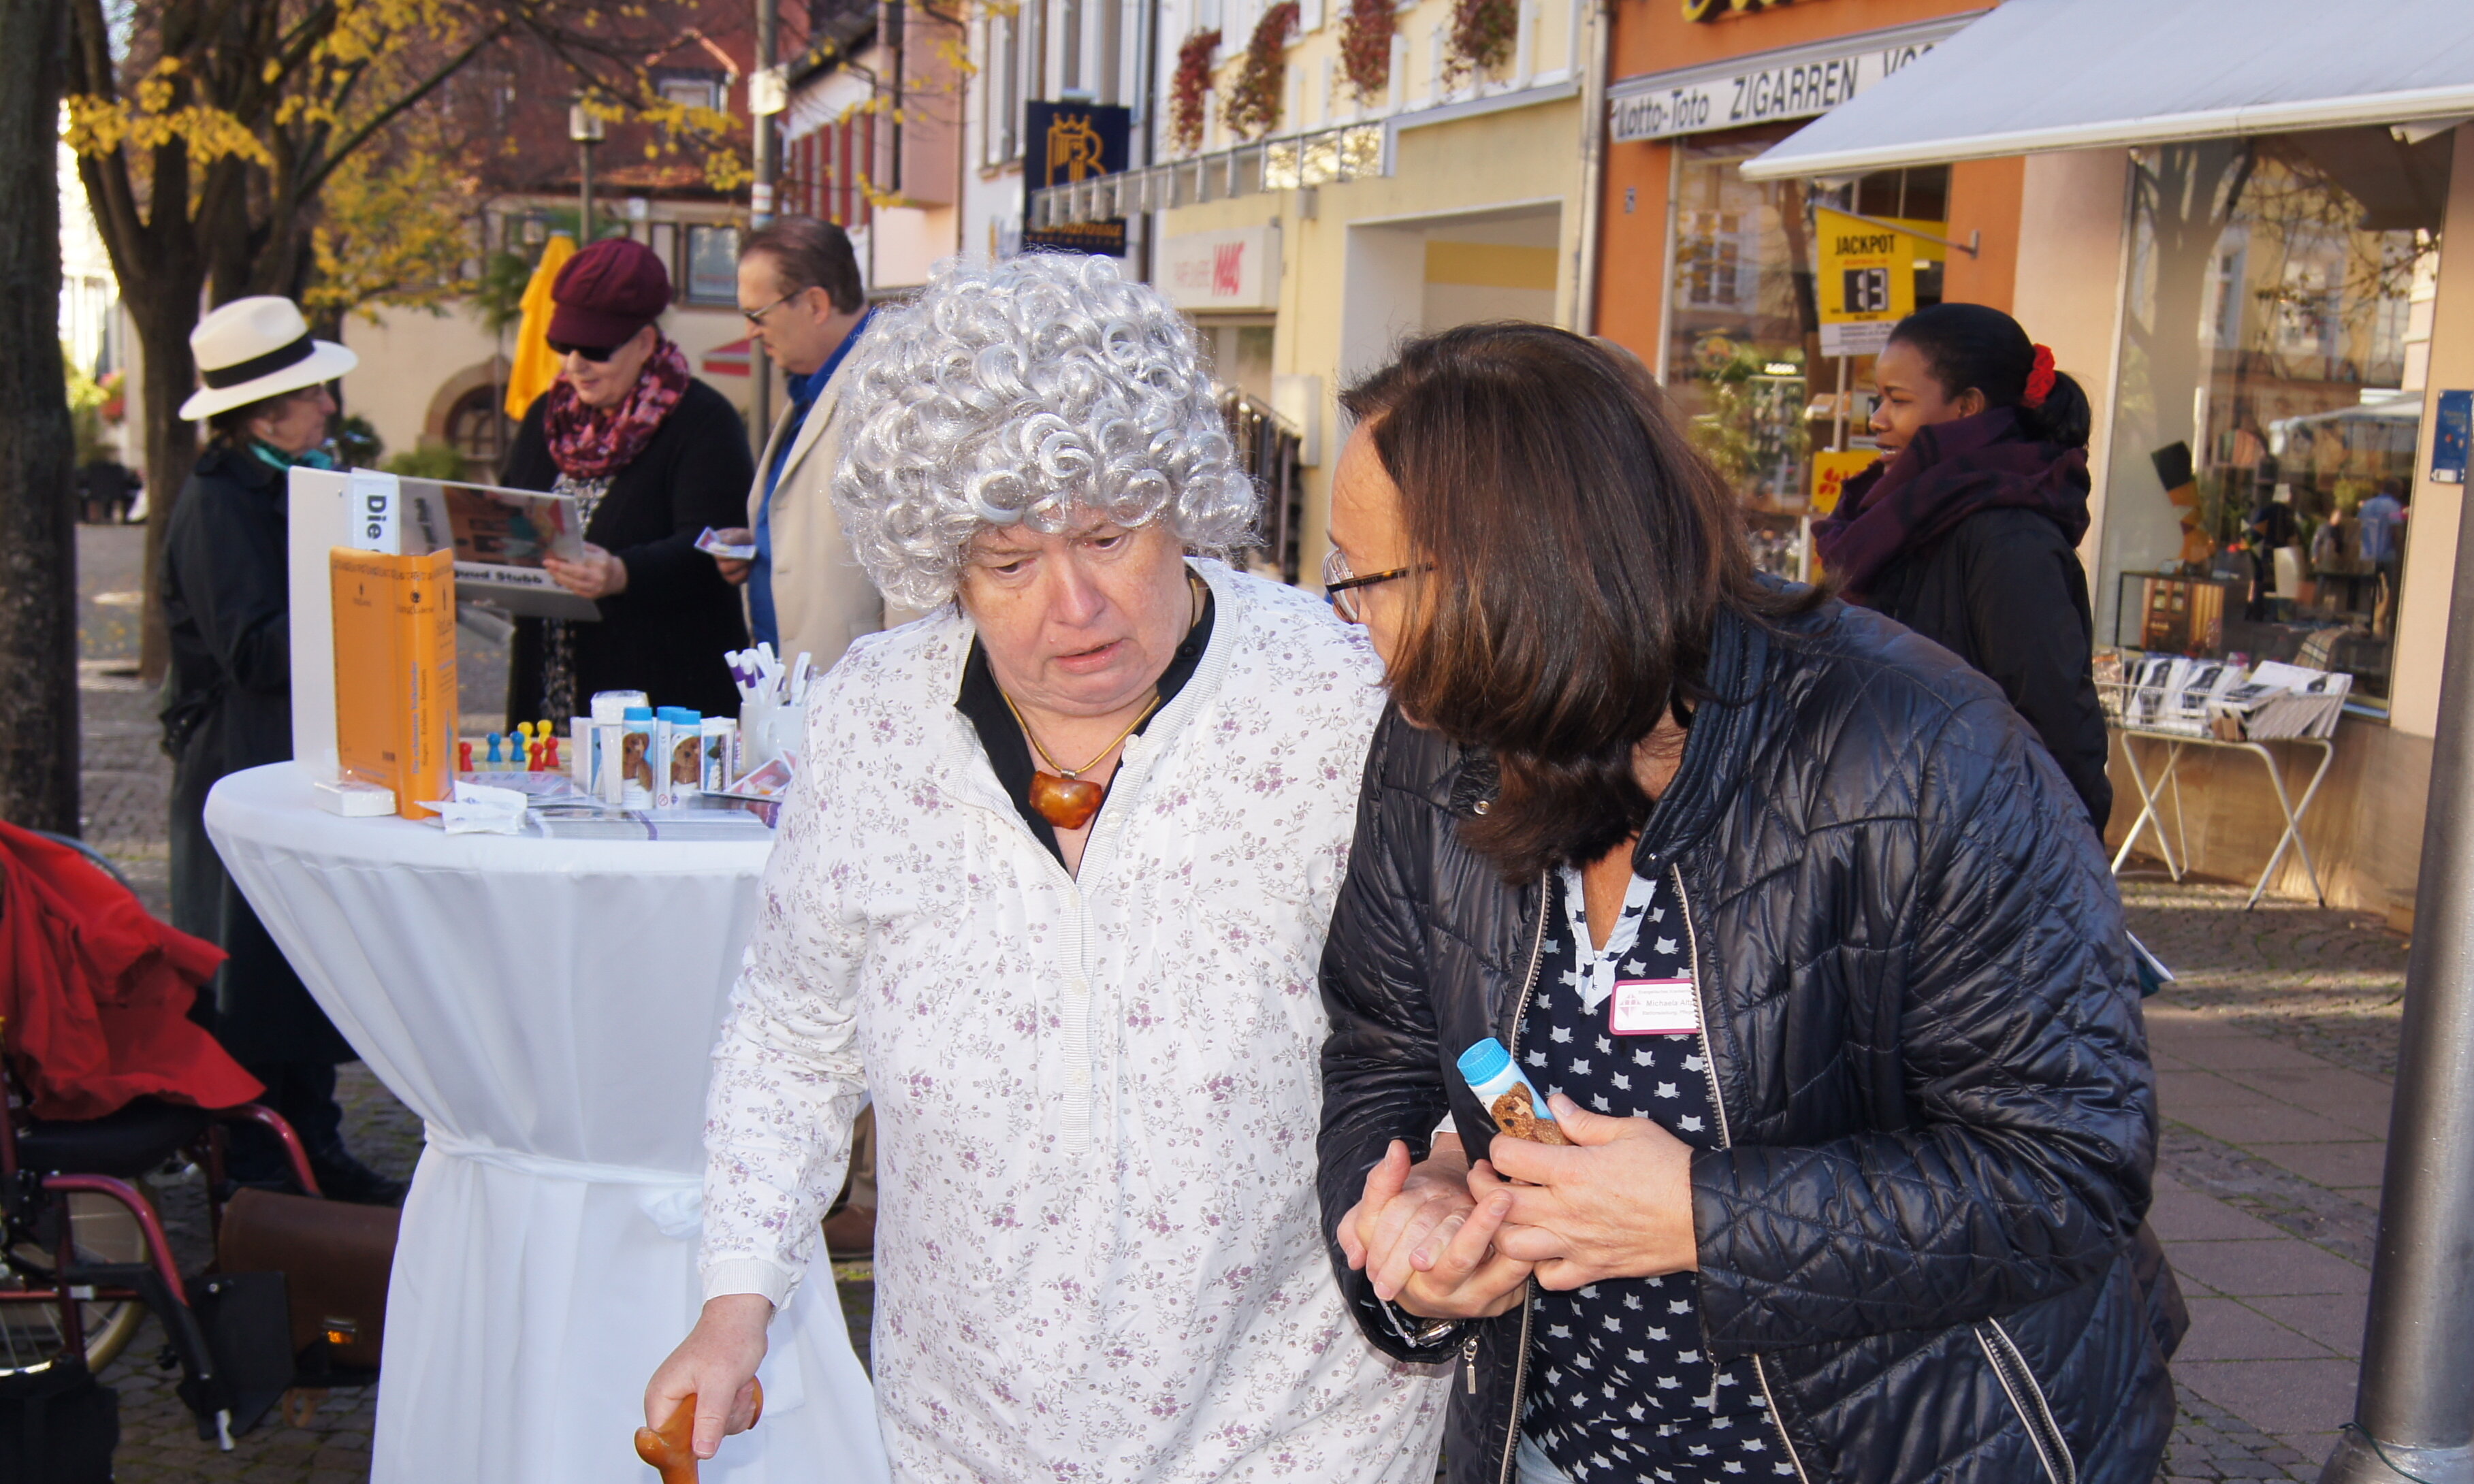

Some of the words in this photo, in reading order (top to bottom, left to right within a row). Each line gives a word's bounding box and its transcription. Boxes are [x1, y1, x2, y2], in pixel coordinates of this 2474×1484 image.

[1617, 88, 1709, 138] Lotto-Toto
[1729, 57, 1859, 120] ZIGARREN
[1835, 234, 1896, 255] JACKPOT
[366, 494, 387, 539] Die
